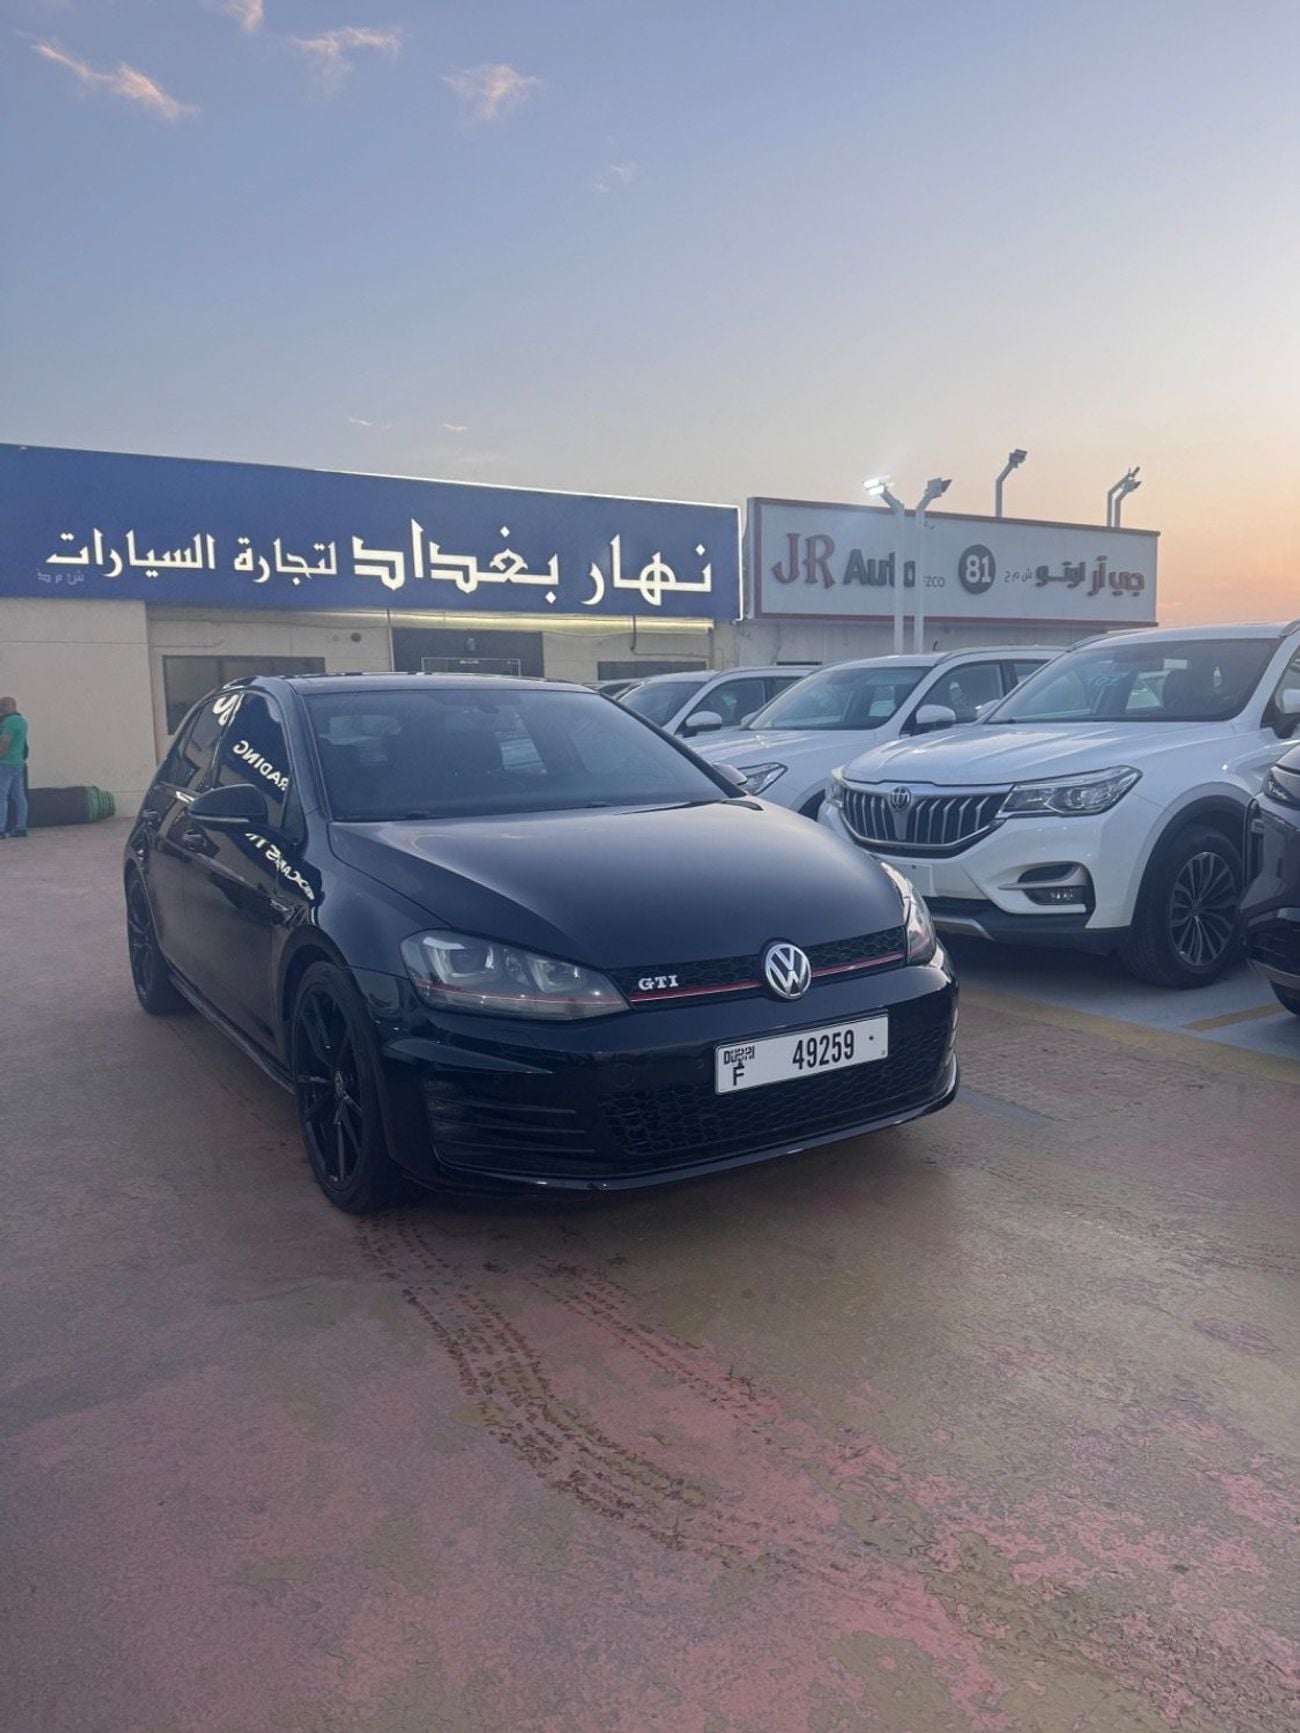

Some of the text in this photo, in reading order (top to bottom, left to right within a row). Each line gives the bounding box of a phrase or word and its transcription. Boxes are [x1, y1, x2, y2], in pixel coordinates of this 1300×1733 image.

[46, 518, 712, 606] نهار بغداد لتجارة السيارات
[771, 533, 835, 588] JR
[923, 575, 946, 588] ZCO
[963, 554, 991, 584] 81
[637, 975, 679, 991] GTI
[792, 1029, 855, 1070] 49259
[732, 1064, 746, 1087] F
